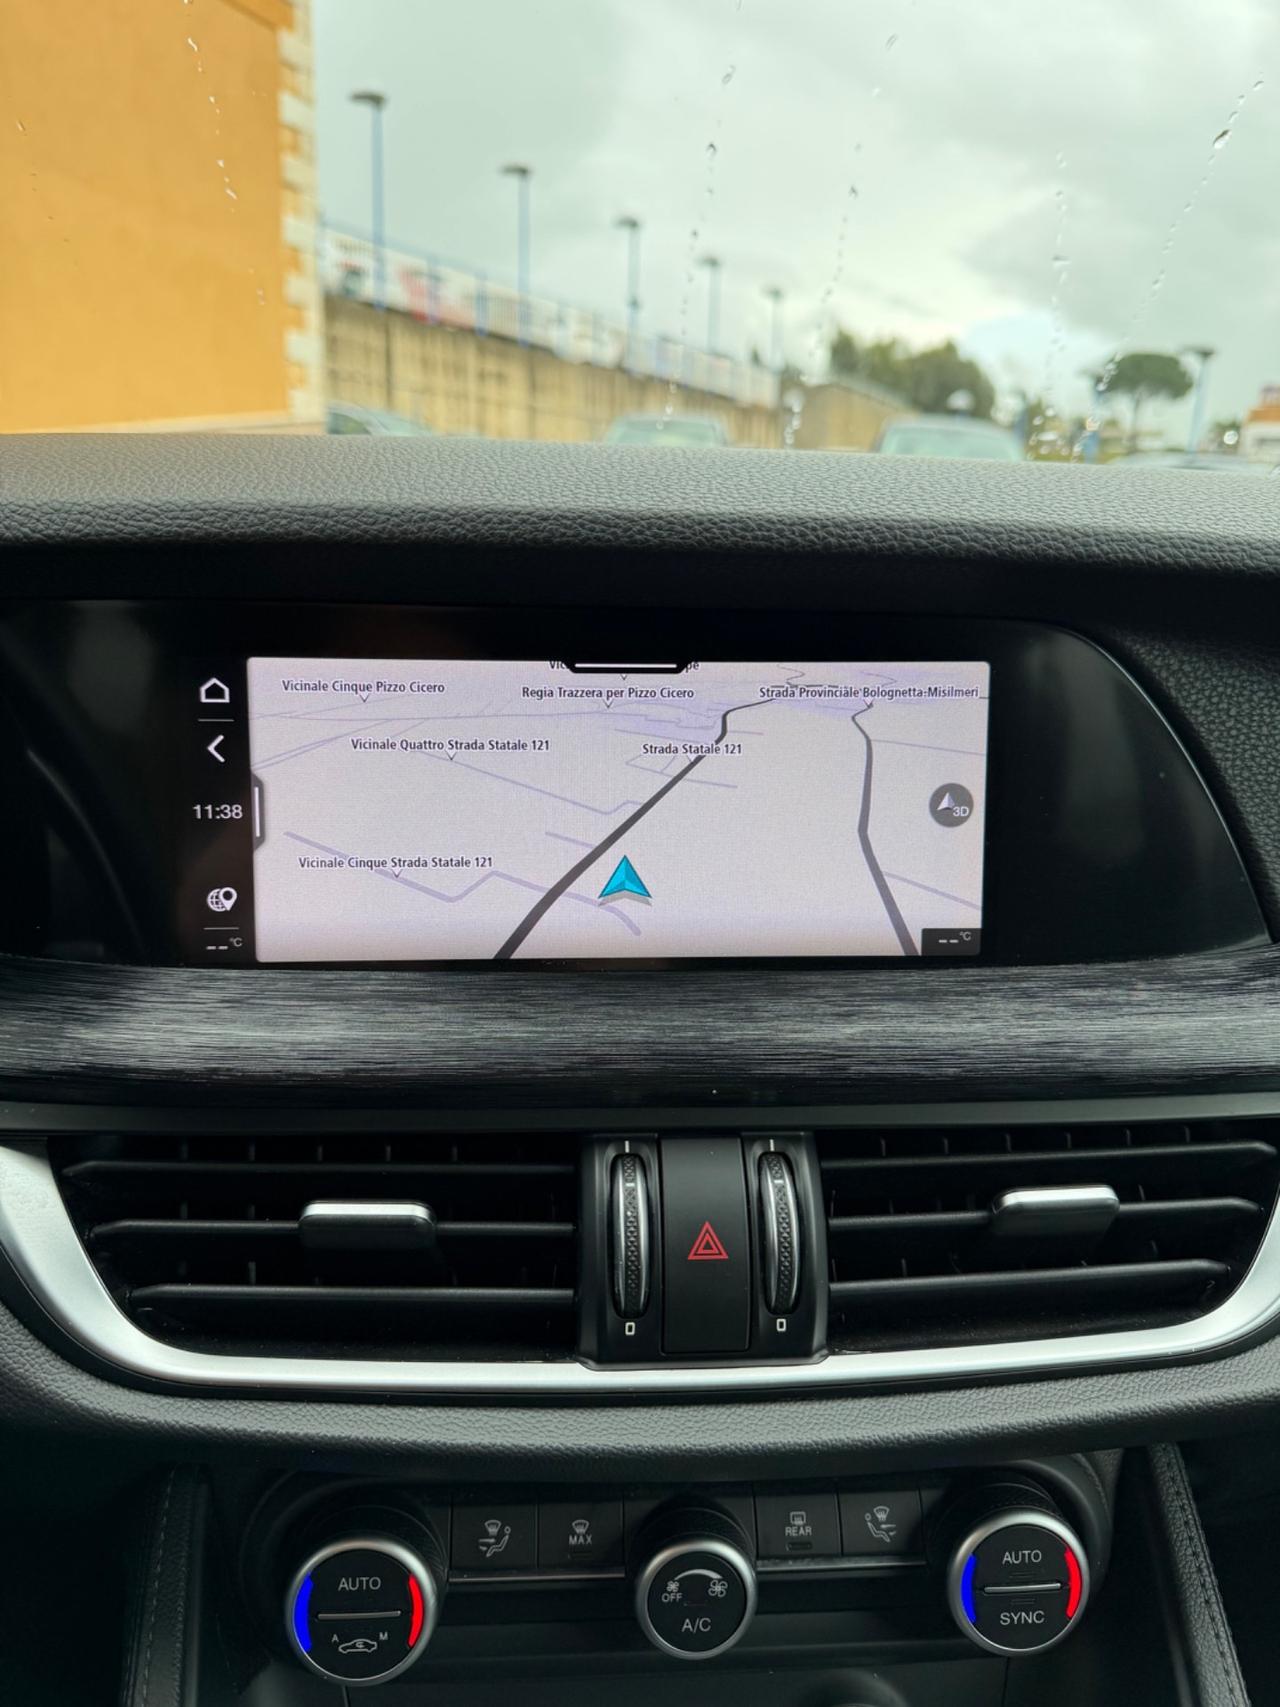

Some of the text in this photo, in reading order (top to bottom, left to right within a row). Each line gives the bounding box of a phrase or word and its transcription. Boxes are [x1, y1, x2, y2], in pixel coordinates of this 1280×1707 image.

[282, 680, 445, 696] Vicinale Cinque Pizzo Cicero
[522, 687, 694, 701] Regia Trazzera per Pizzo Cicero
[759, 686, 796, 698] Strada
[799, 686, 860, 698] Provinciale
[351, 738, 550, 752] Vicinale Quattro Strada Statale 121
[642, 743, 742, 755] Strada Statale 121
[192, 804, 243, 819] 11:38
[953, 805, 969, 817] 3D
[299, 856, 493, 871] Vicinale Cinque Strada Statale 121
[785, 1525, 812, 1537] REAR
[568, 1534, 592, 1546] MAX
[1002, 1550, 1042, 1565] AUTO
[338, 1577, 381, 1591] AUTO
[661, 1593, 683, 1603] OFF
[682, 1617, 711, 1633] A/C
[1000, 1610, 1045, 1626] SYNC
